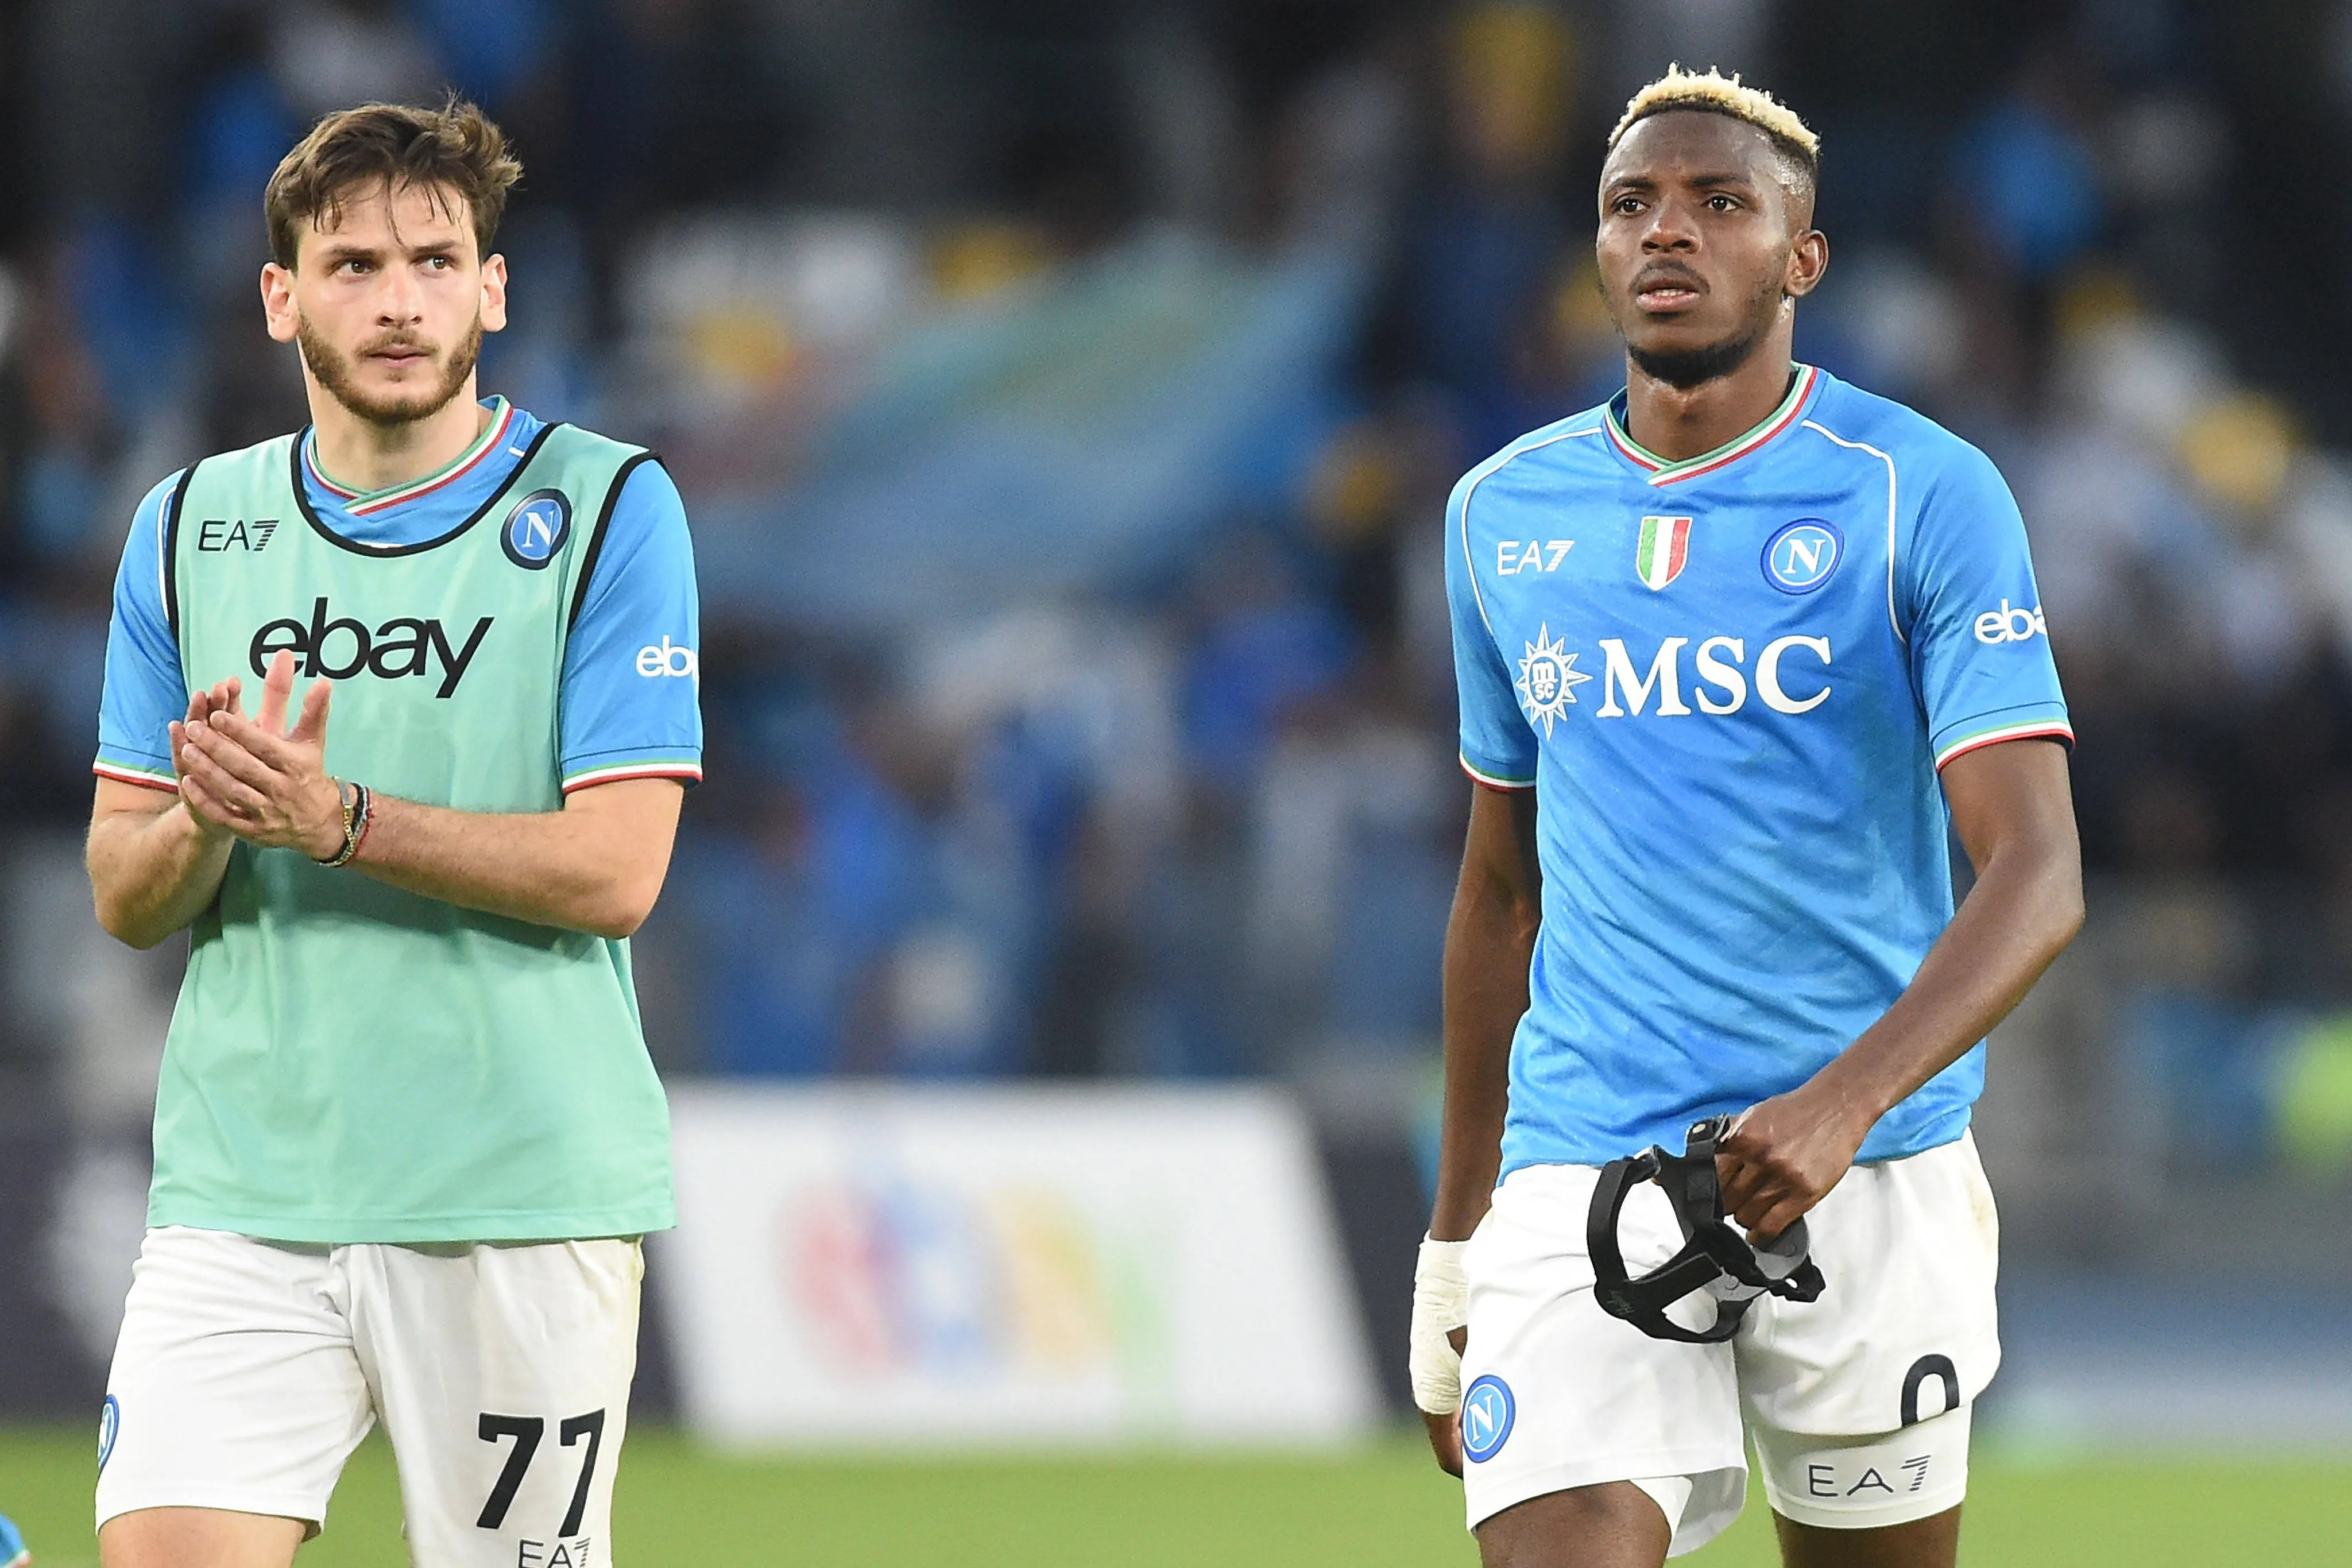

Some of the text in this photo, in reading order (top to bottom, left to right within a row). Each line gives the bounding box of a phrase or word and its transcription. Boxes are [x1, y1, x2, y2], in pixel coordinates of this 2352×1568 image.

[198, 520, 280, 552] EA7
[521, 510, 555, 548] N
[1497, 540, 1576, 575] EA7
[1782, 539, 1826, 574] N
[249, 597, 495, 699] ebay
[636, 634, 699, 682] eb
[1596, 635, 1832, 717] MSC
[1469, 1395, 1493, 1443] N
[477, 1407, 605, 1538] 77
[1809, 1455, 1931, 1496] EA7
